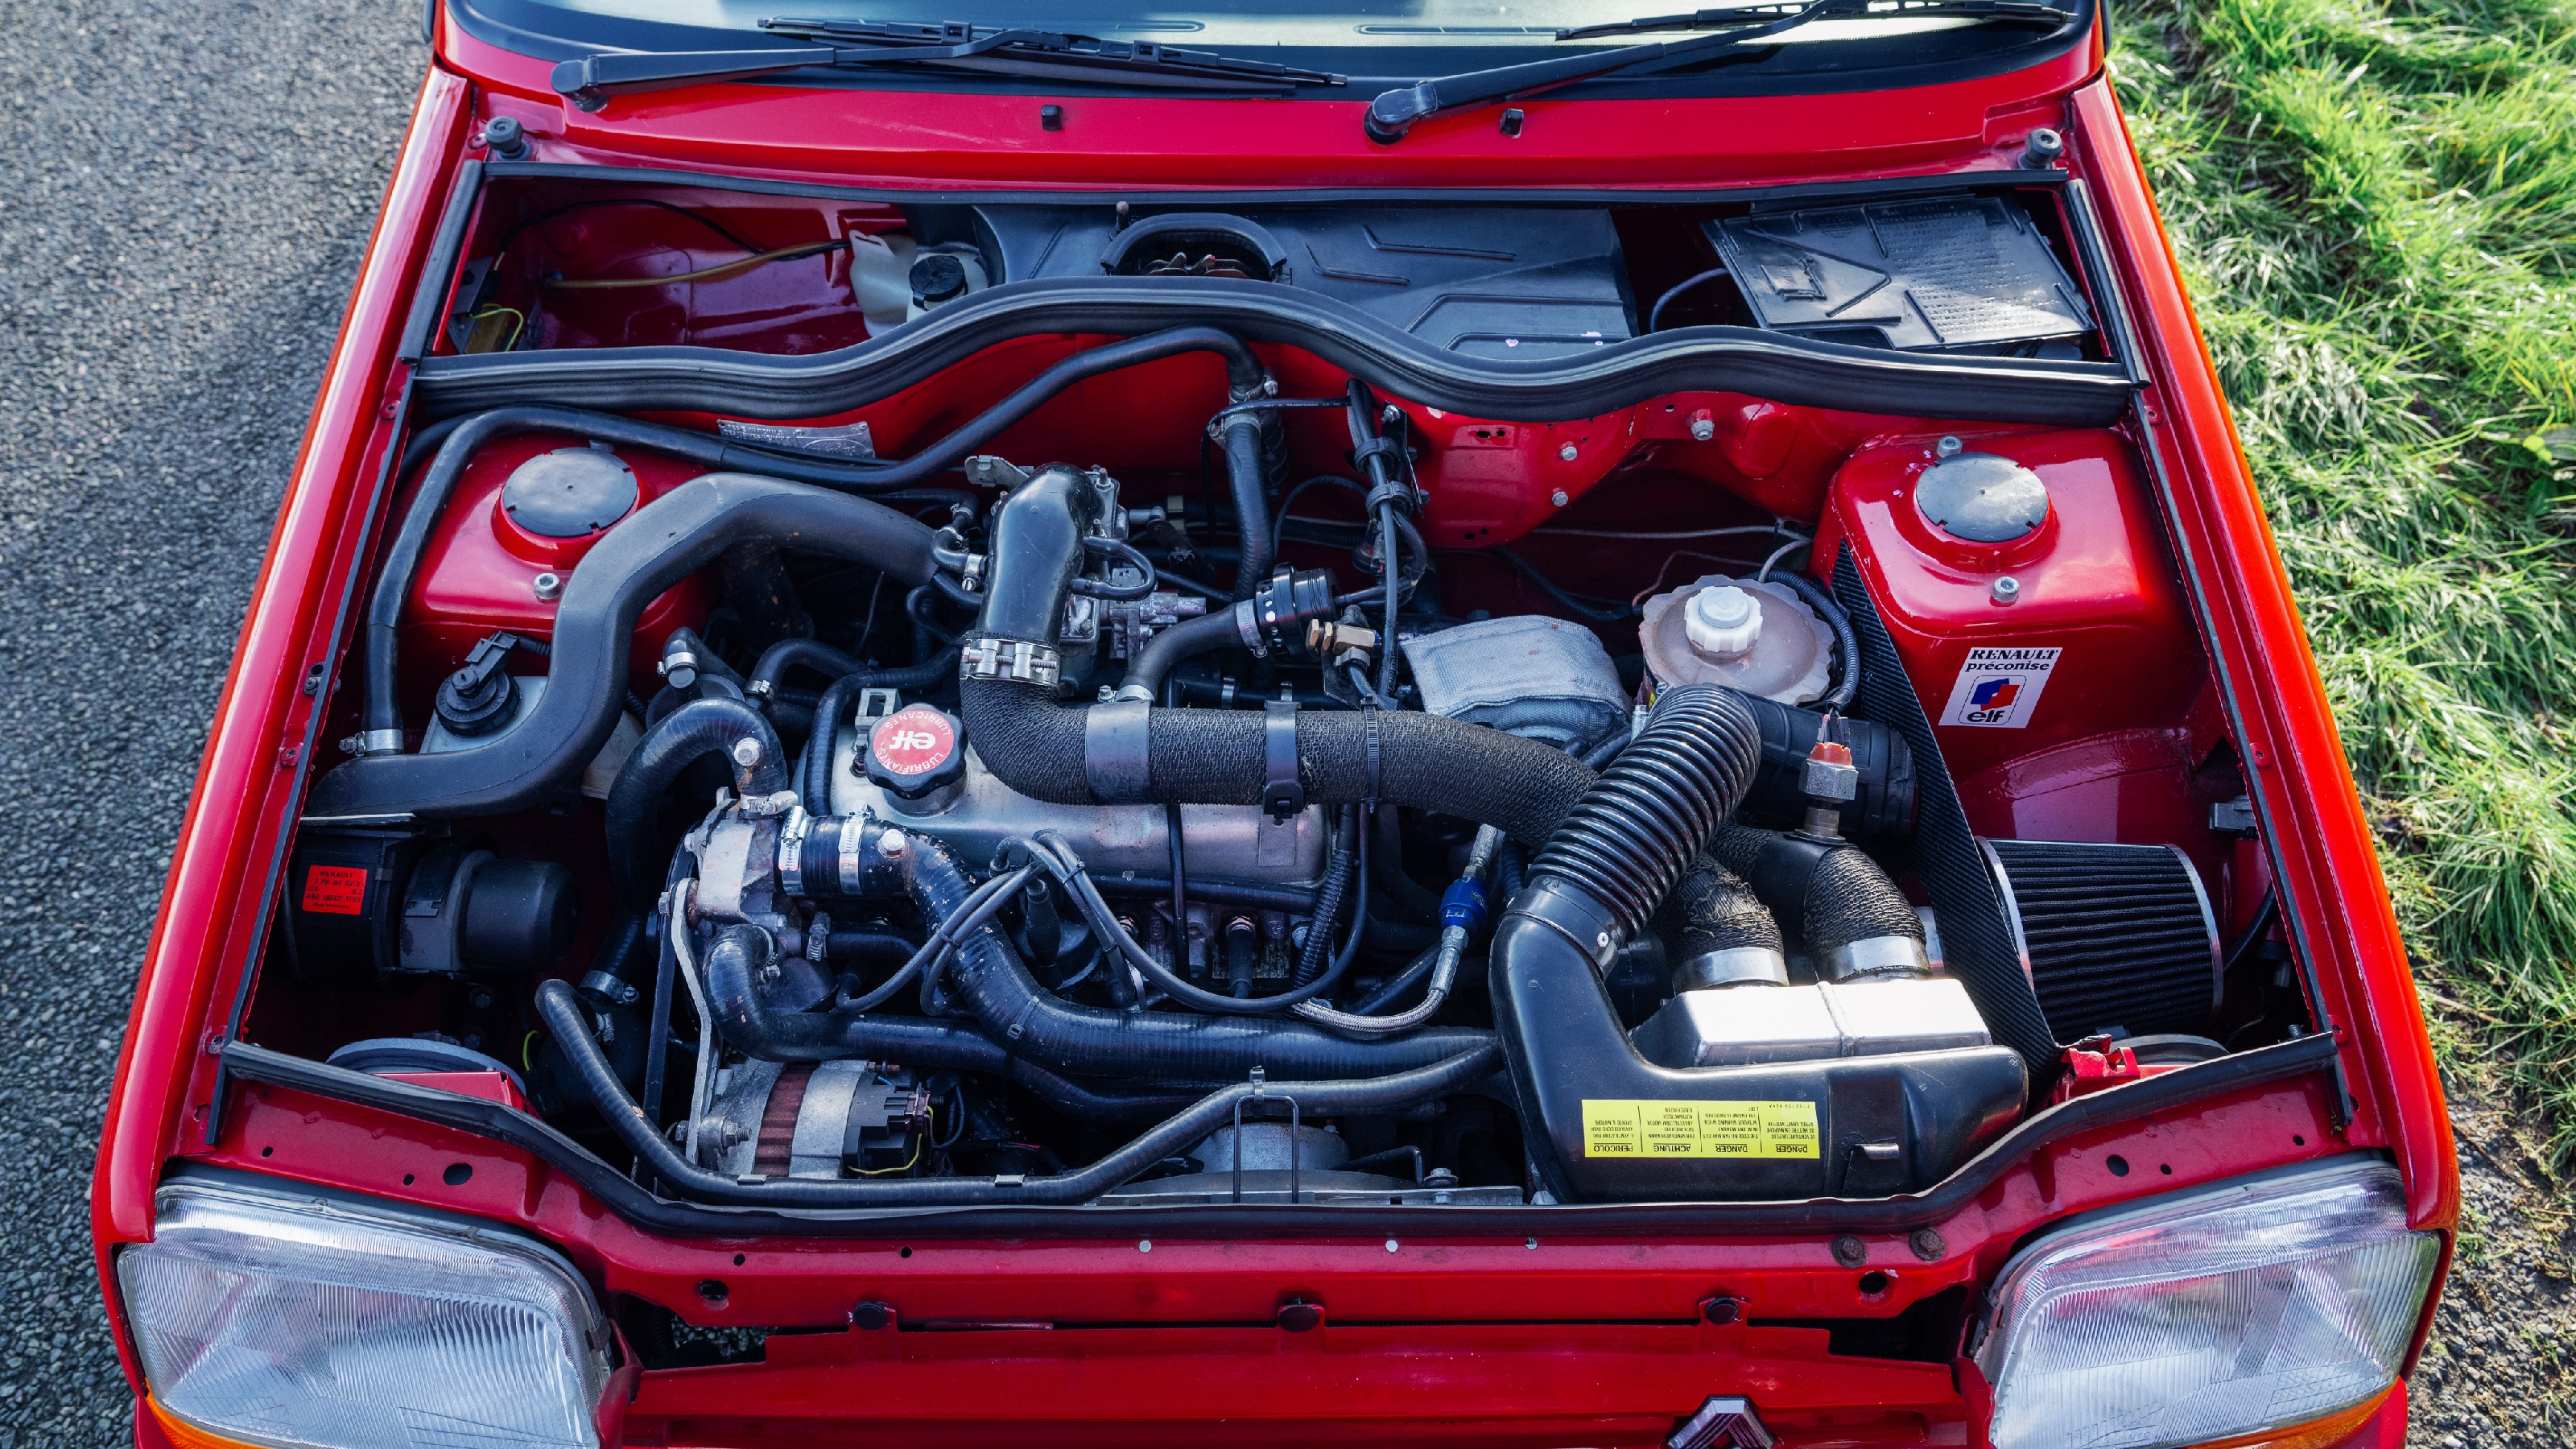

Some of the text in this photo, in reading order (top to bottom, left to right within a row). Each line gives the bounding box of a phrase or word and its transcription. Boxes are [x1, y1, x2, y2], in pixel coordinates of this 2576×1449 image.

[1969, 650, 2058, 660] RENAULT
[1965, 661, 2050, 672] préconise
[886, 712, 951, 736] LUBRICANTS
[1967, 710, 2004, 722] elf
[890, 730, 935, 750] elf
[877, 749, 943, 774] LUBRIFIANTS
